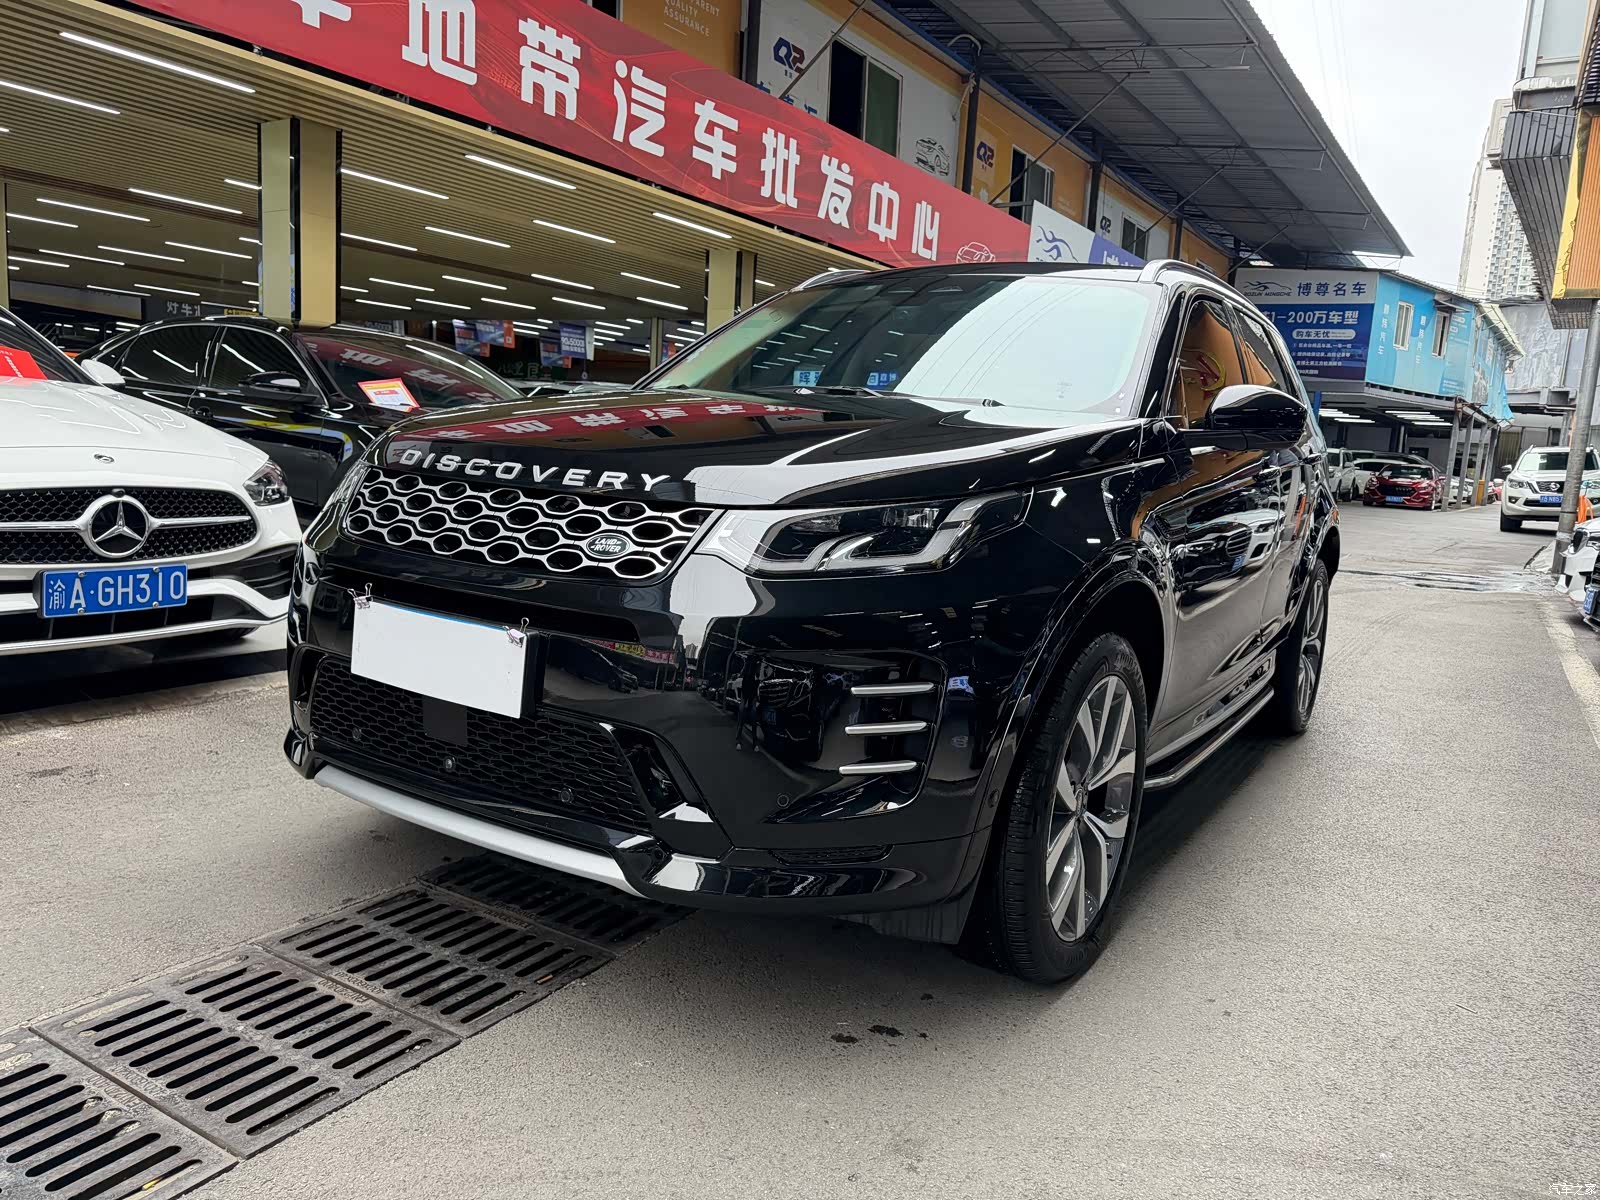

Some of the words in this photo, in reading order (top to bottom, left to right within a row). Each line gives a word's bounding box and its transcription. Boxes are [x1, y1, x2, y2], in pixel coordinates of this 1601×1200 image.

[663, 6, 710, 37] ASSURANCE
[1297, 282, 1367, 297] 博尊名车
[1295, 330, 1331, 338] 购车无忧
[399, 449, 671, 492] DISCOVERY
[595, 537, 618, 545] LAND
[593, 544, 621, 553] ROVER
